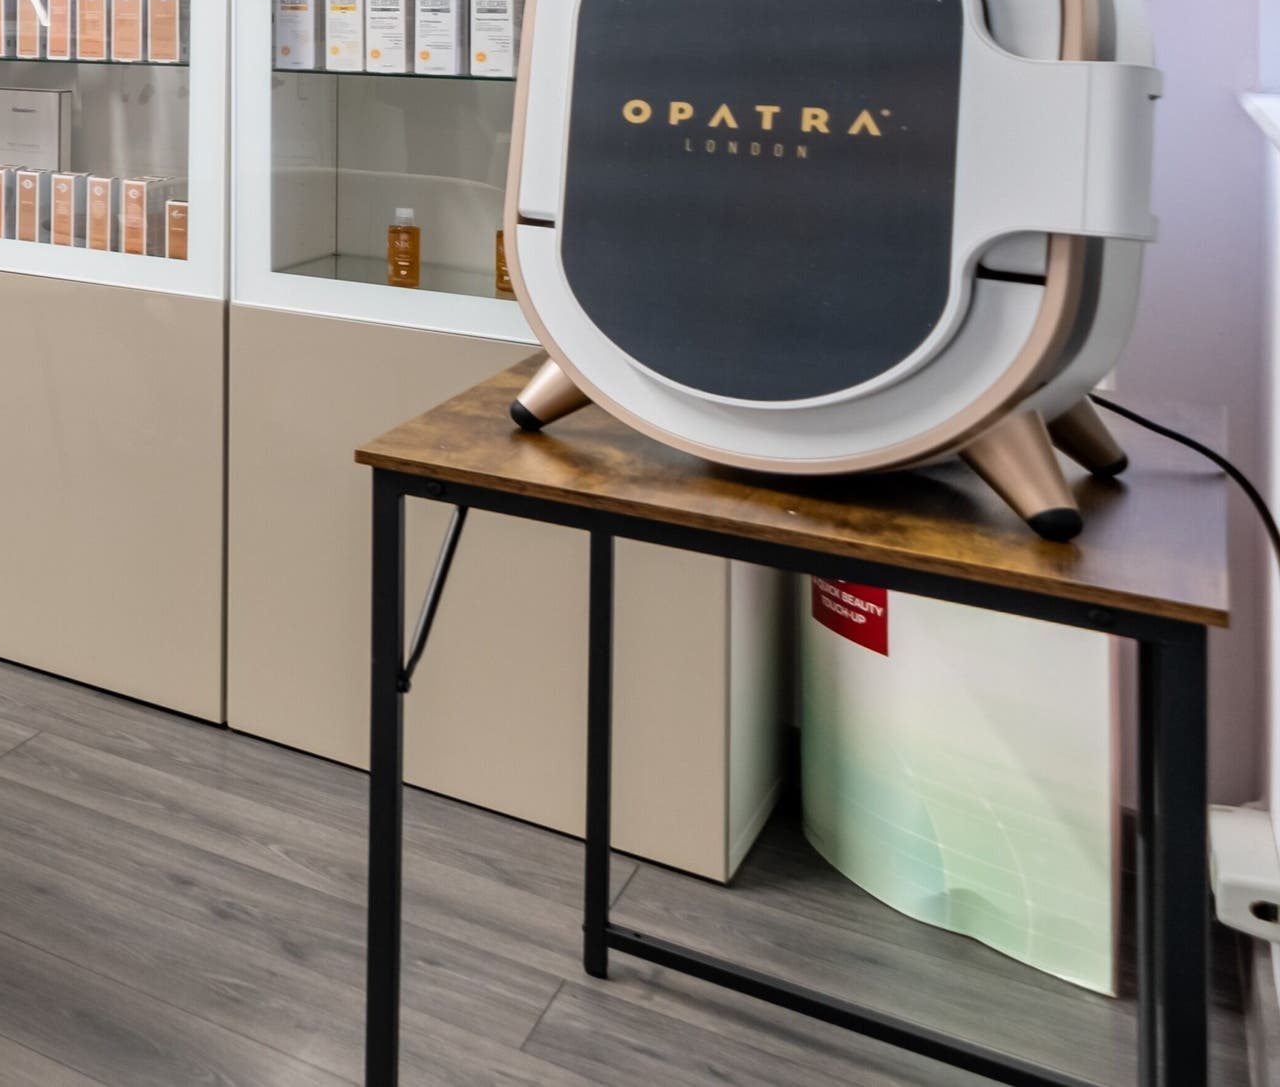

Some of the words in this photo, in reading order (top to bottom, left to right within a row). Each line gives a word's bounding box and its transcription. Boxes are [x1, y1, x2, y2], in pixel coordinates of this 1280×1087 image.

[622, 99, 883, 137] OPATRA
[684, 138, 808, 159] LONDON
[820, 594, 867, 624] TOUCH-UP
[841, 591, 884, 617] BEAUTY
